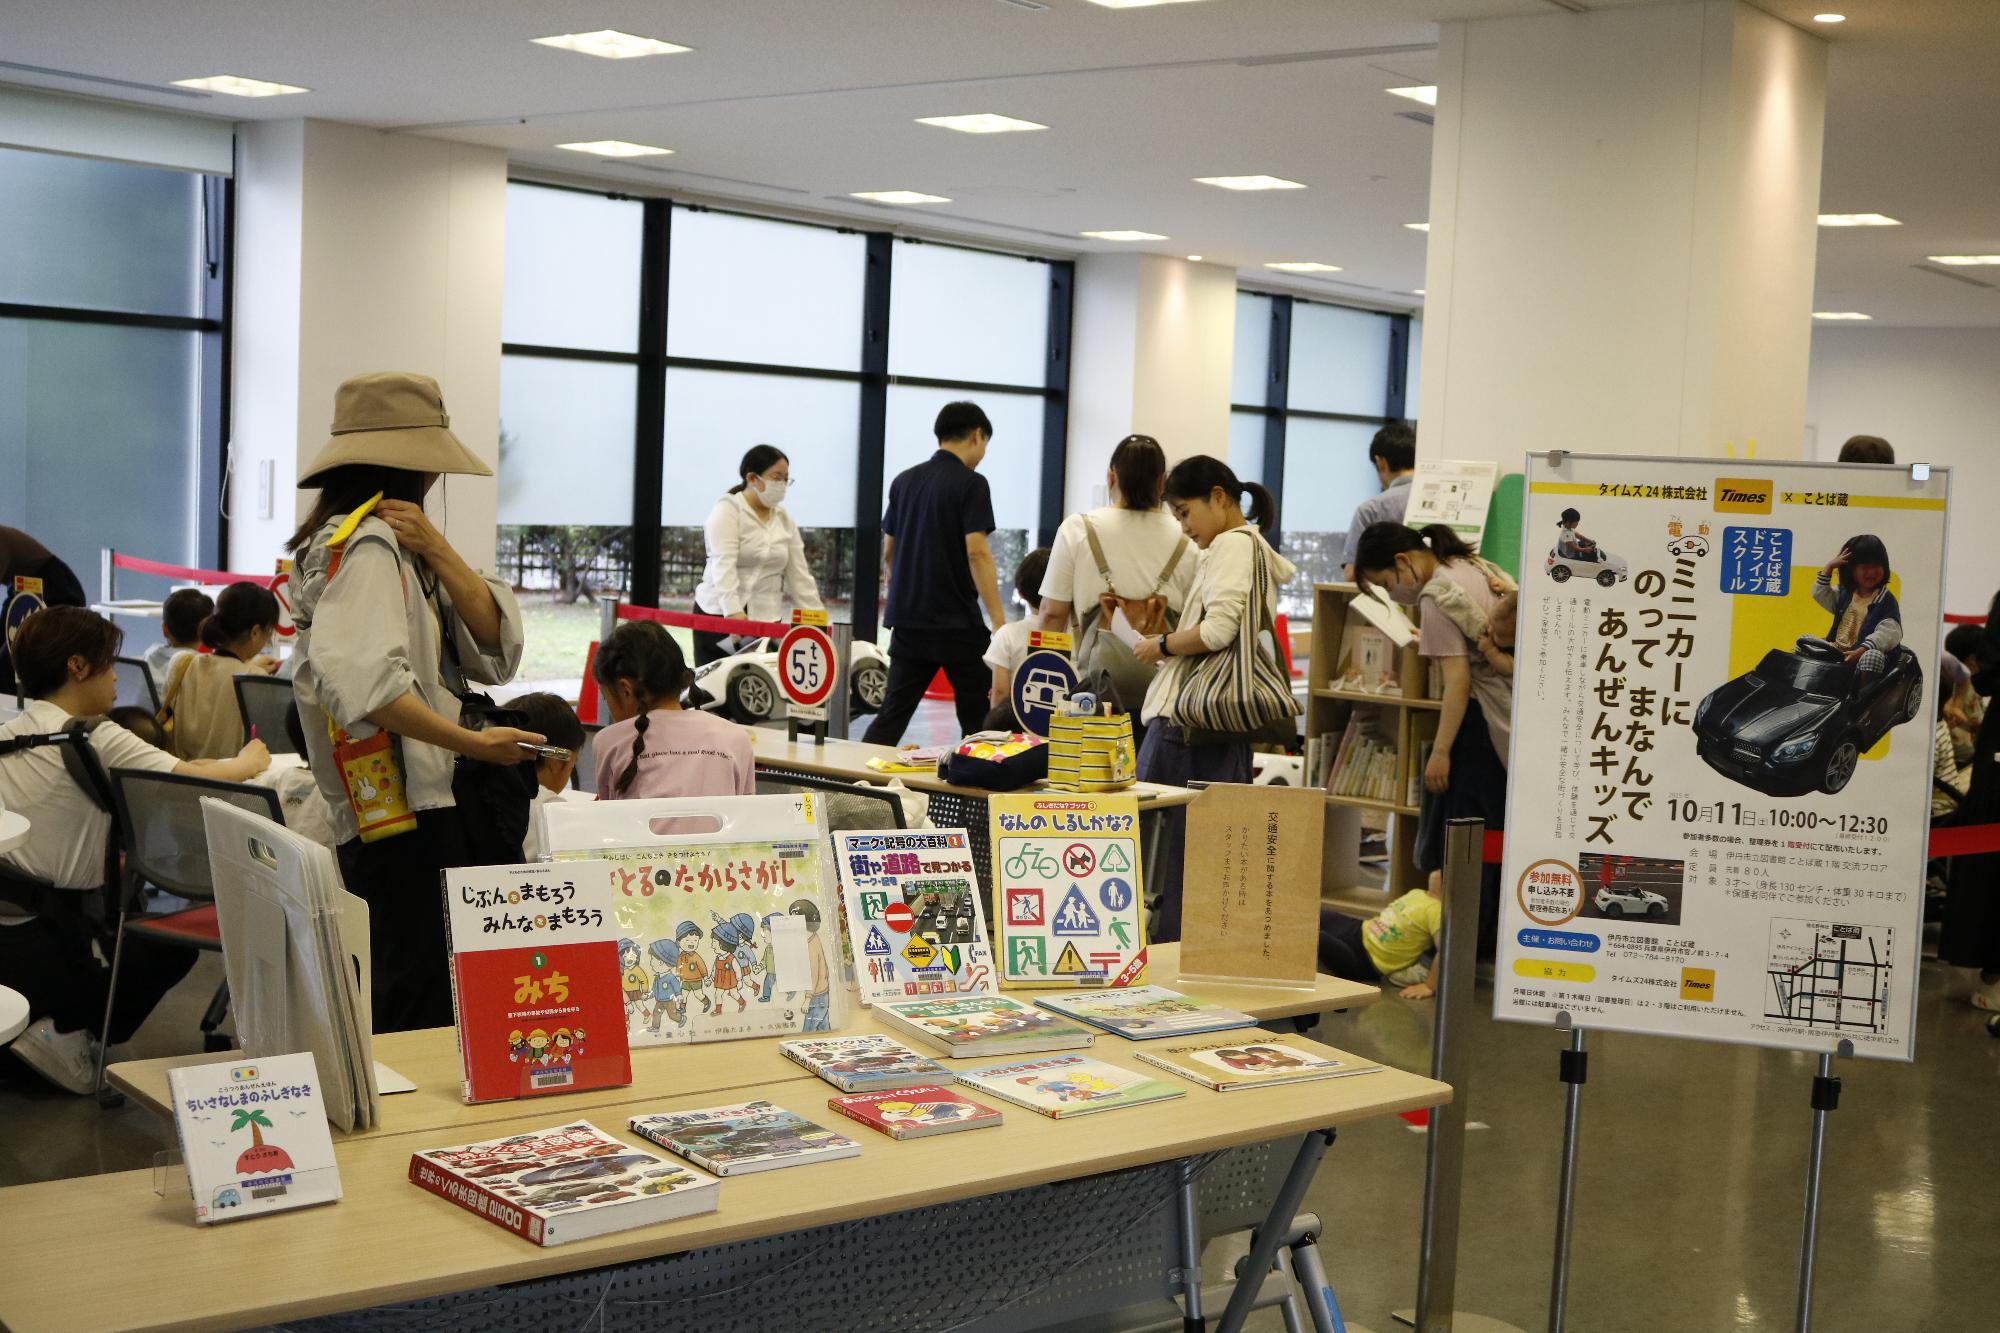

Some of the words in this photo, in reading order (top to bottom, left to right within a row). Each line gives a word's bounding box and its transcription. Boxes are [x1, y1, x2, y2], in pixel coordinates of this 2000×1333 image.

[1720, 488, 1767, 504] Times
[1803, 492, 1849, 507] ことば蔵
[1729, 530, 1749, 591] スクール
[1748, 530, 1768, 592] ドライブ
[1765, 531, 1783, 594] ことば蔵
[1661, 557, 1698, 726] ミニカーに
[1584, 606, 1629, 844] あんぜんキッズ
[998, 813, 1048, 832] なんの
[1052, 813, 1134, 832] しるしかな?
[848, 835, 949, 850] マーク・記号の大百科
[848, 852, 973, 877] 街や道路で見つかる
[853, 876, 898, 887] マーク・記号
[1529, 871, 1573, 887] 参加無料
[1528, 885, 1575, 898] 申し込み不要
[1522, 935, 1594, 949] 主催・お問い合わせ
[975, 949, 987, 957] FAX
[513, 970, 570, 1005] みち
[1684, 979, 1712, 990] Times
[185, 1084, 312, 1112] ちいさなしまのふしぎなき
